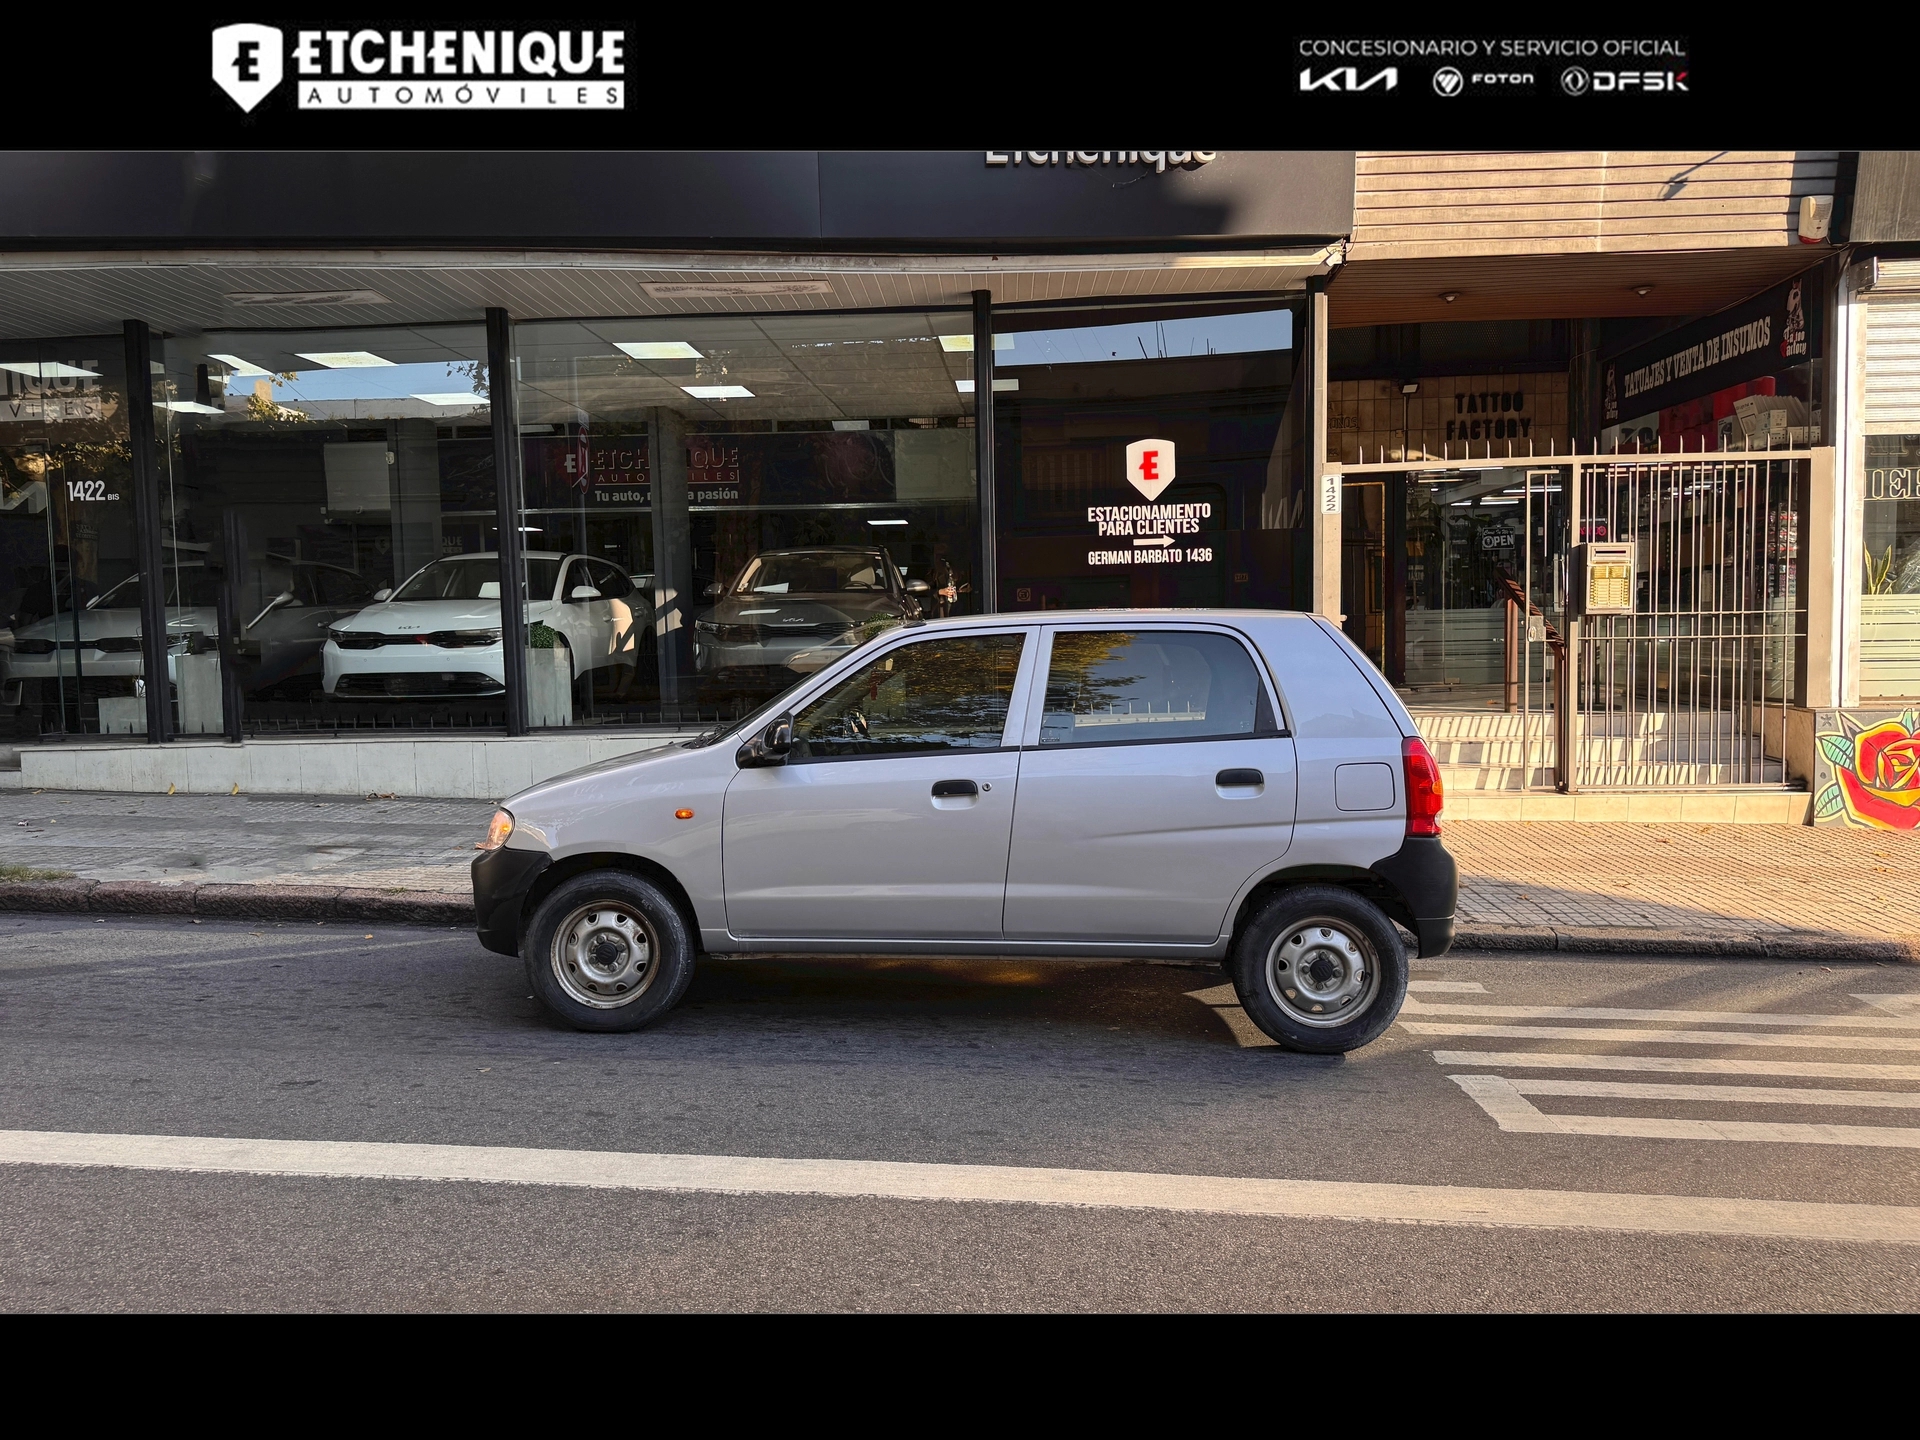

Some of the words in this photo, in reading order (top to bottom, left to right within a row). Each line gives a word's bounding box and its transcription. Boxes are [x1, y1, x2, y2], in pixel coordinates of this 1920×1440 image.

[1624, 361, 1665, 398] TATUAJES
[1665, 356, 1673, 382] Y
[1673, 343, 1705, 379] VENTA
[1706, 336, 1720, 367] DE
[1721, 316, 1771, 360] INSUMOS
[1455, 391, 1524, 414] TATTOO
[1446, 418, 1531, 441] FACTORY
[591, 447, 738, 470] ETCHQUE
[597, 471, 736, 482] AUTOILES
[67, 480, 106, 501] 1422
[595, 490, 609, 501] Tu
[612, 491, 645, 503] auto,
[697, 487, 738, 501] pasión
[1325, 477, 1337, 512] 1422
[1087, 503, 1211, 522] ESTACIONAMIENTO
[1098, 520, 1134, 536] PARA
[1136, 518, 1200, 535] CLIENTES
[1482, 535, 1514, 548] OPEN
[1088, 550, 1132, 565] GERMAN
[1134, 549, 1182, 563] BARBATO
[1185, 547, 1213, 562] 1436
